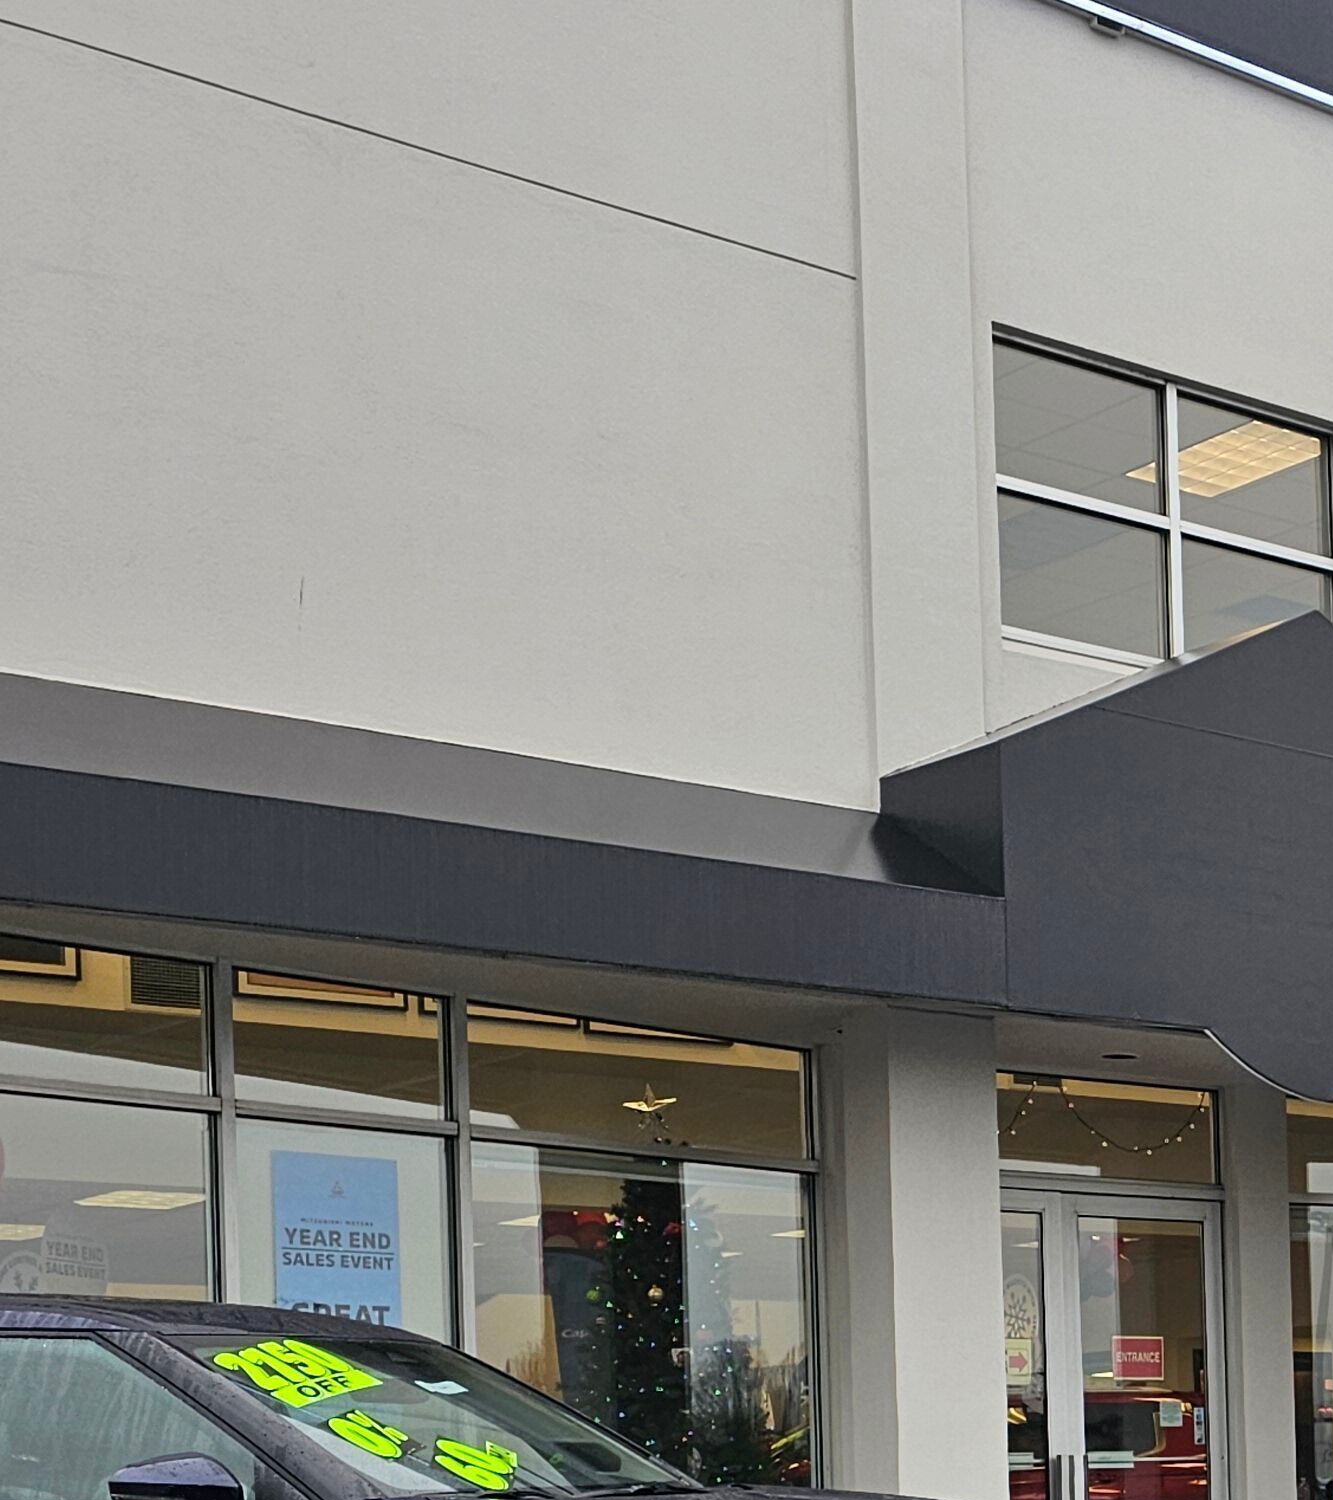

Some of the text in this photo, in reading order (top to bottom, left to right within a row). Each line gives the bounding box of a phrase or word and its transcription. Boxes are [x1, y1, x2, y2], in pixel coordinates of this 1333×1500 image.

[284, 1227, 391, 1250] YEAR END
[46, 1240, 104, 1262] YEAR END
[45, 1261, 76, 1276] SALES
[282, 1252, 395, 1271] SALES EVENT
[1116, 1350, 1161, 1364] ENTRANCE
[297, 1374, 351, 1398] OFF
